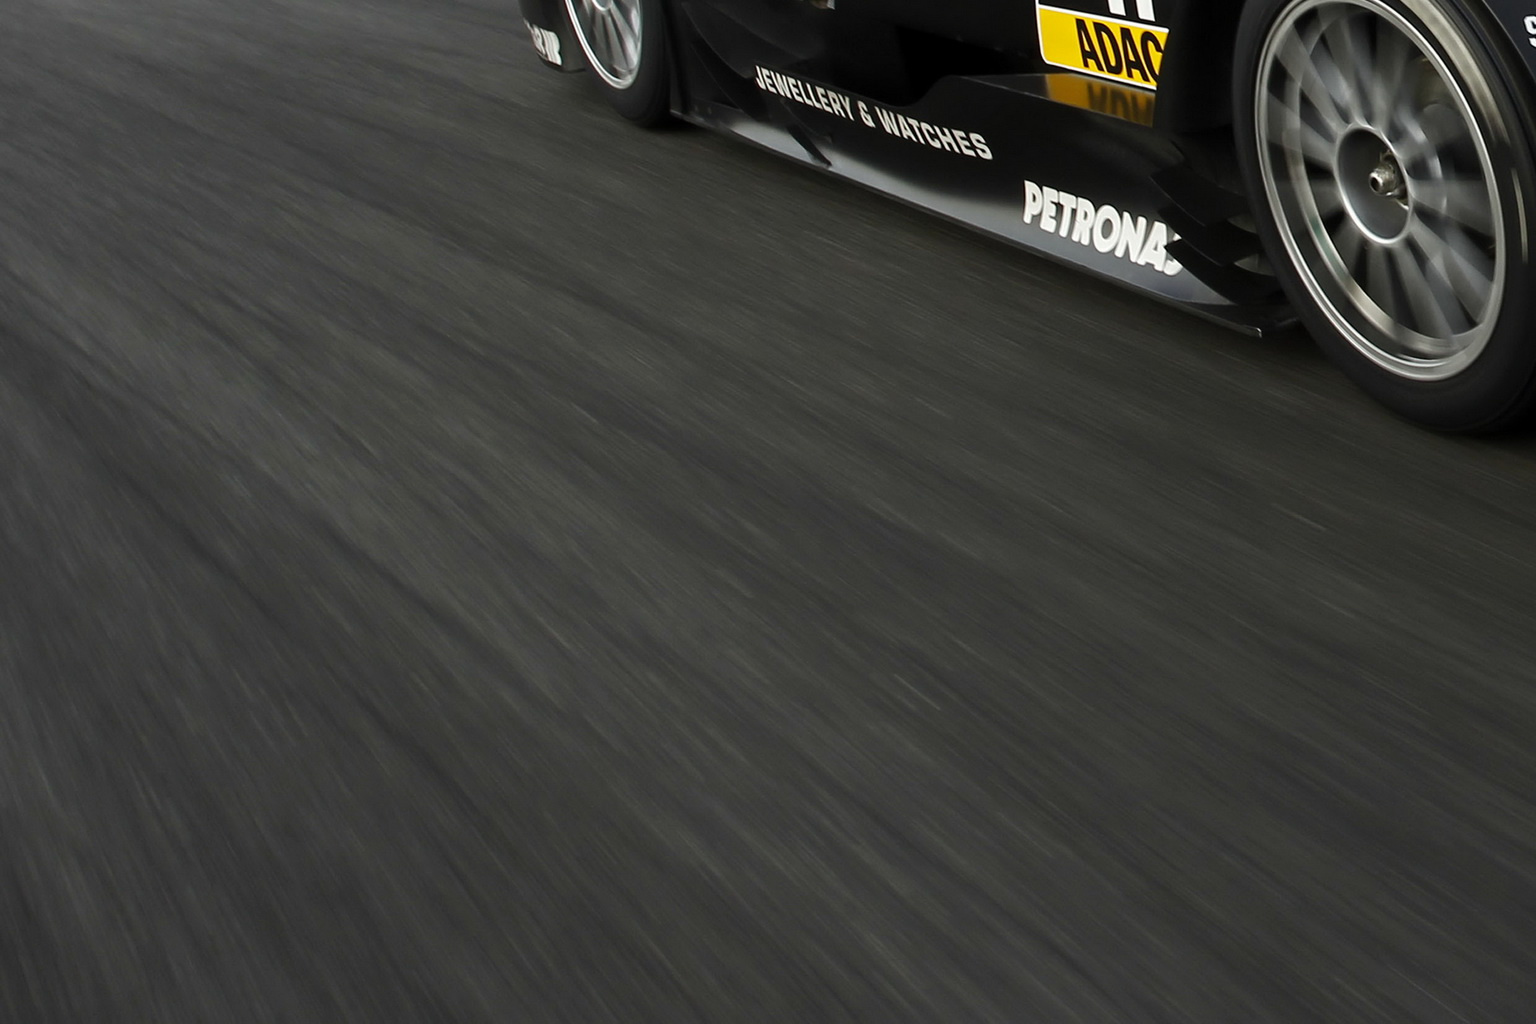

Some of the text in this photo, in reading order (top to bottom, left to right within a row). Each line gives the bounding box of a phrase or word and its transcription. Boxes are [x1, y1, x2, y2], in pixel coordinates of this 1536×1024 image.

[1075, 18, 1163, 83] ADAC
[755, 65, 993, 161] JEWELLERY & WATCHES
